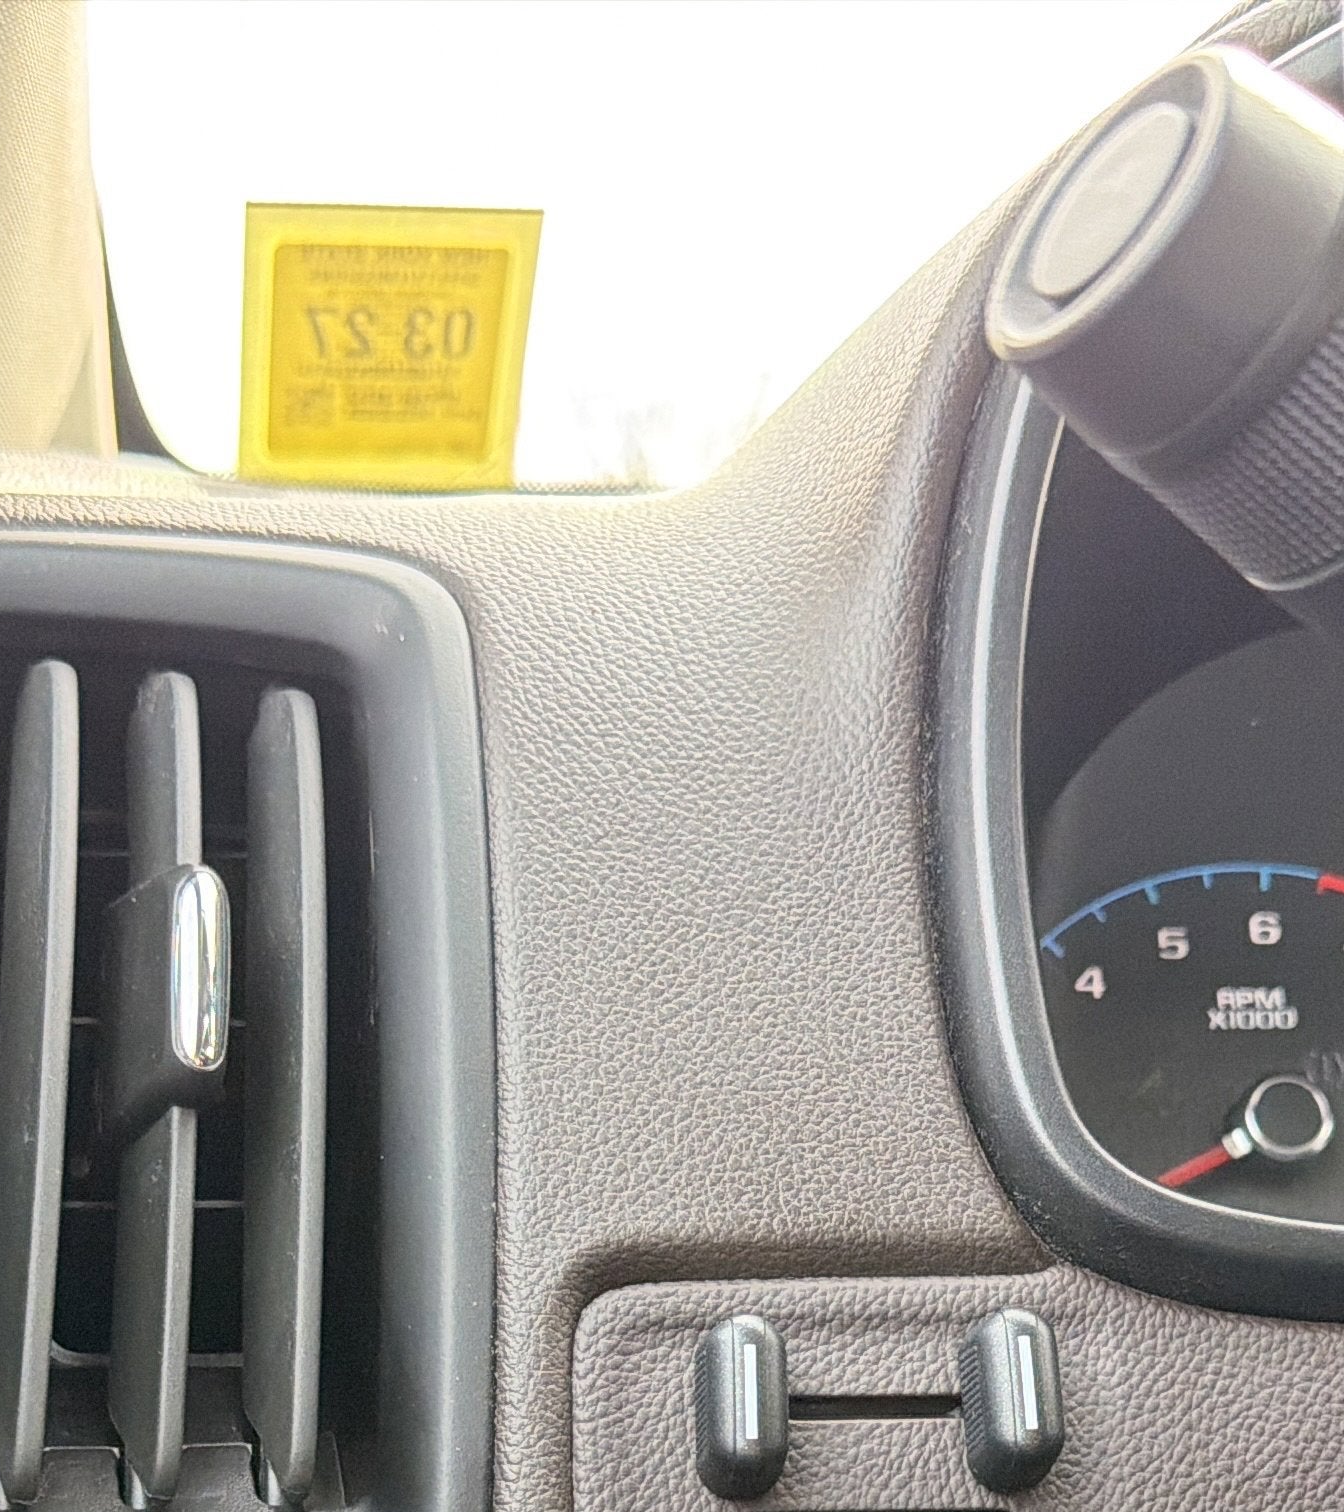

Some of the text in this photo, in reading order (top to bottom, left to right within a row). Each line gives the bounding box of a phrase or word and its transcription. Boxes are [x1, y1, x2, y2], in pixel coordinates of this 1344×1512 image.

[1074, 965, 1106, 999] 4
[1157, 926, 1190, 960] 5
[1248, 911, 1282, 945] 6
[1216, 986, 1287, 1010] RPM
